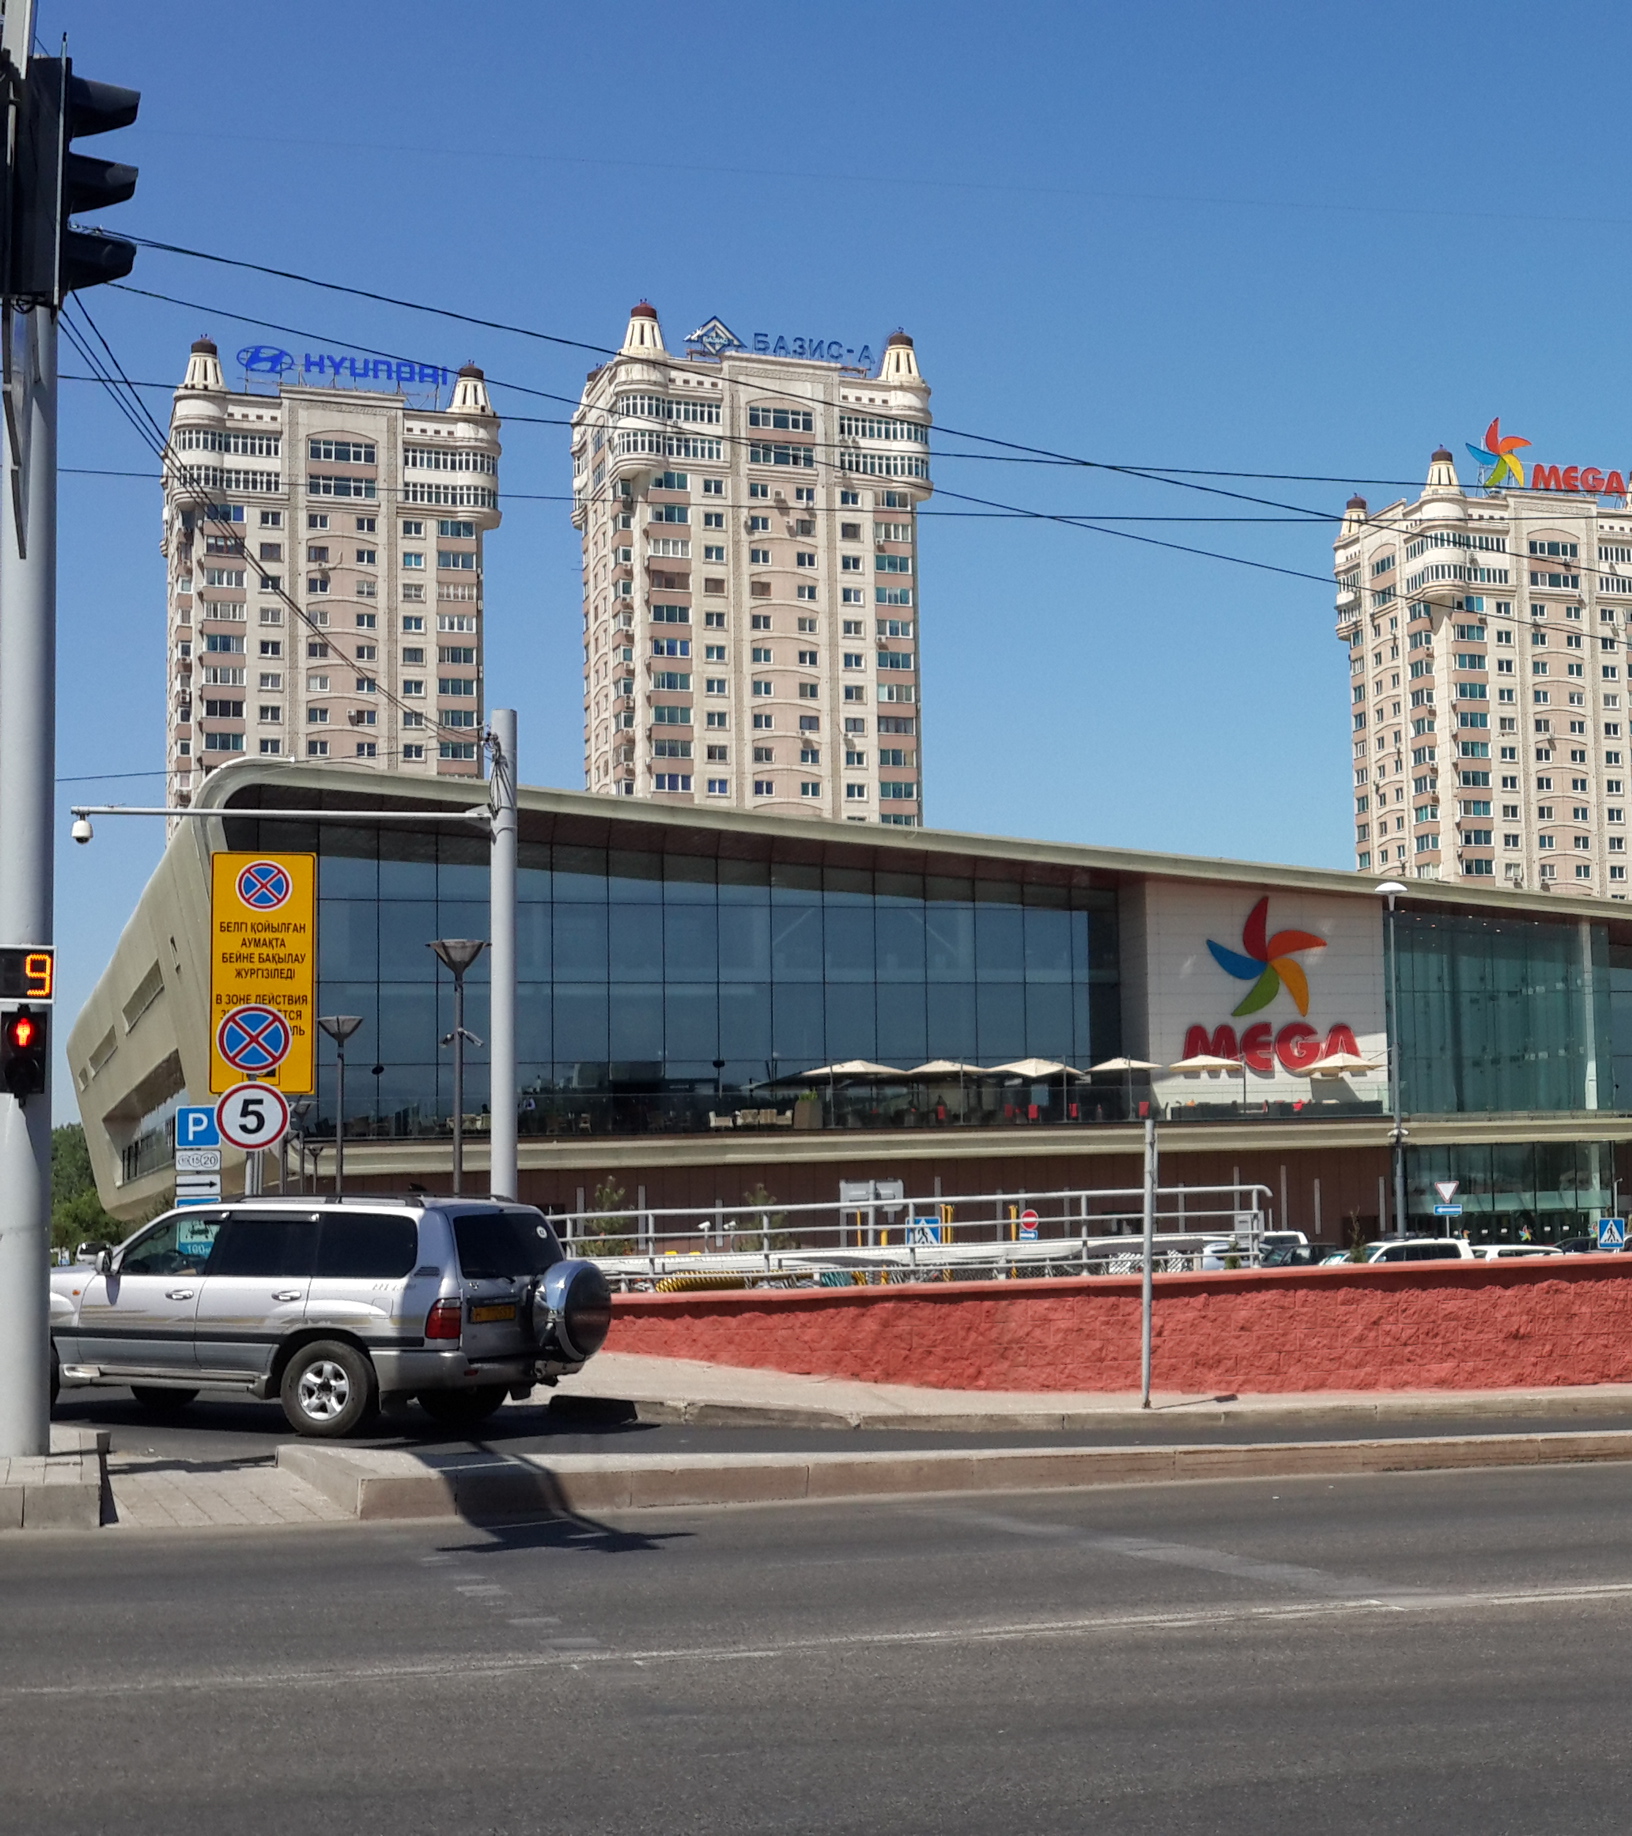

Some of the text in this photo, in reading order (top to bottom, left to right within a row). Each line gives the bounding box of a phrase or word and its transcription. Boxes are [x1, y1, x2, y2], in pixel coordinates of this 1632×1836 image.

[753, 332, 876, 364] БАЗИС-А
[304, 352, 448, 385] HYUNDAI
[1531, 463, 1627, 497] MEGA
[219, 921, 248, 933] БЕЛГІ
[221, 951, 306, 965] БЕЙНЕ БАҚЫЛАУ
[240, 937, 286, 950] АУМАҚТА
[25, 953, 51, 997] 9
[216, 992, 308, 1006] В ЗОНЕ ДЕЙСТВИЯ
[1182, 1021, 1362, 1072] MEGA
[187, 1113, 208, 1141] P
[238, 1098, 265, 1135] 5
[203, 1155, 216, 1166] 20
